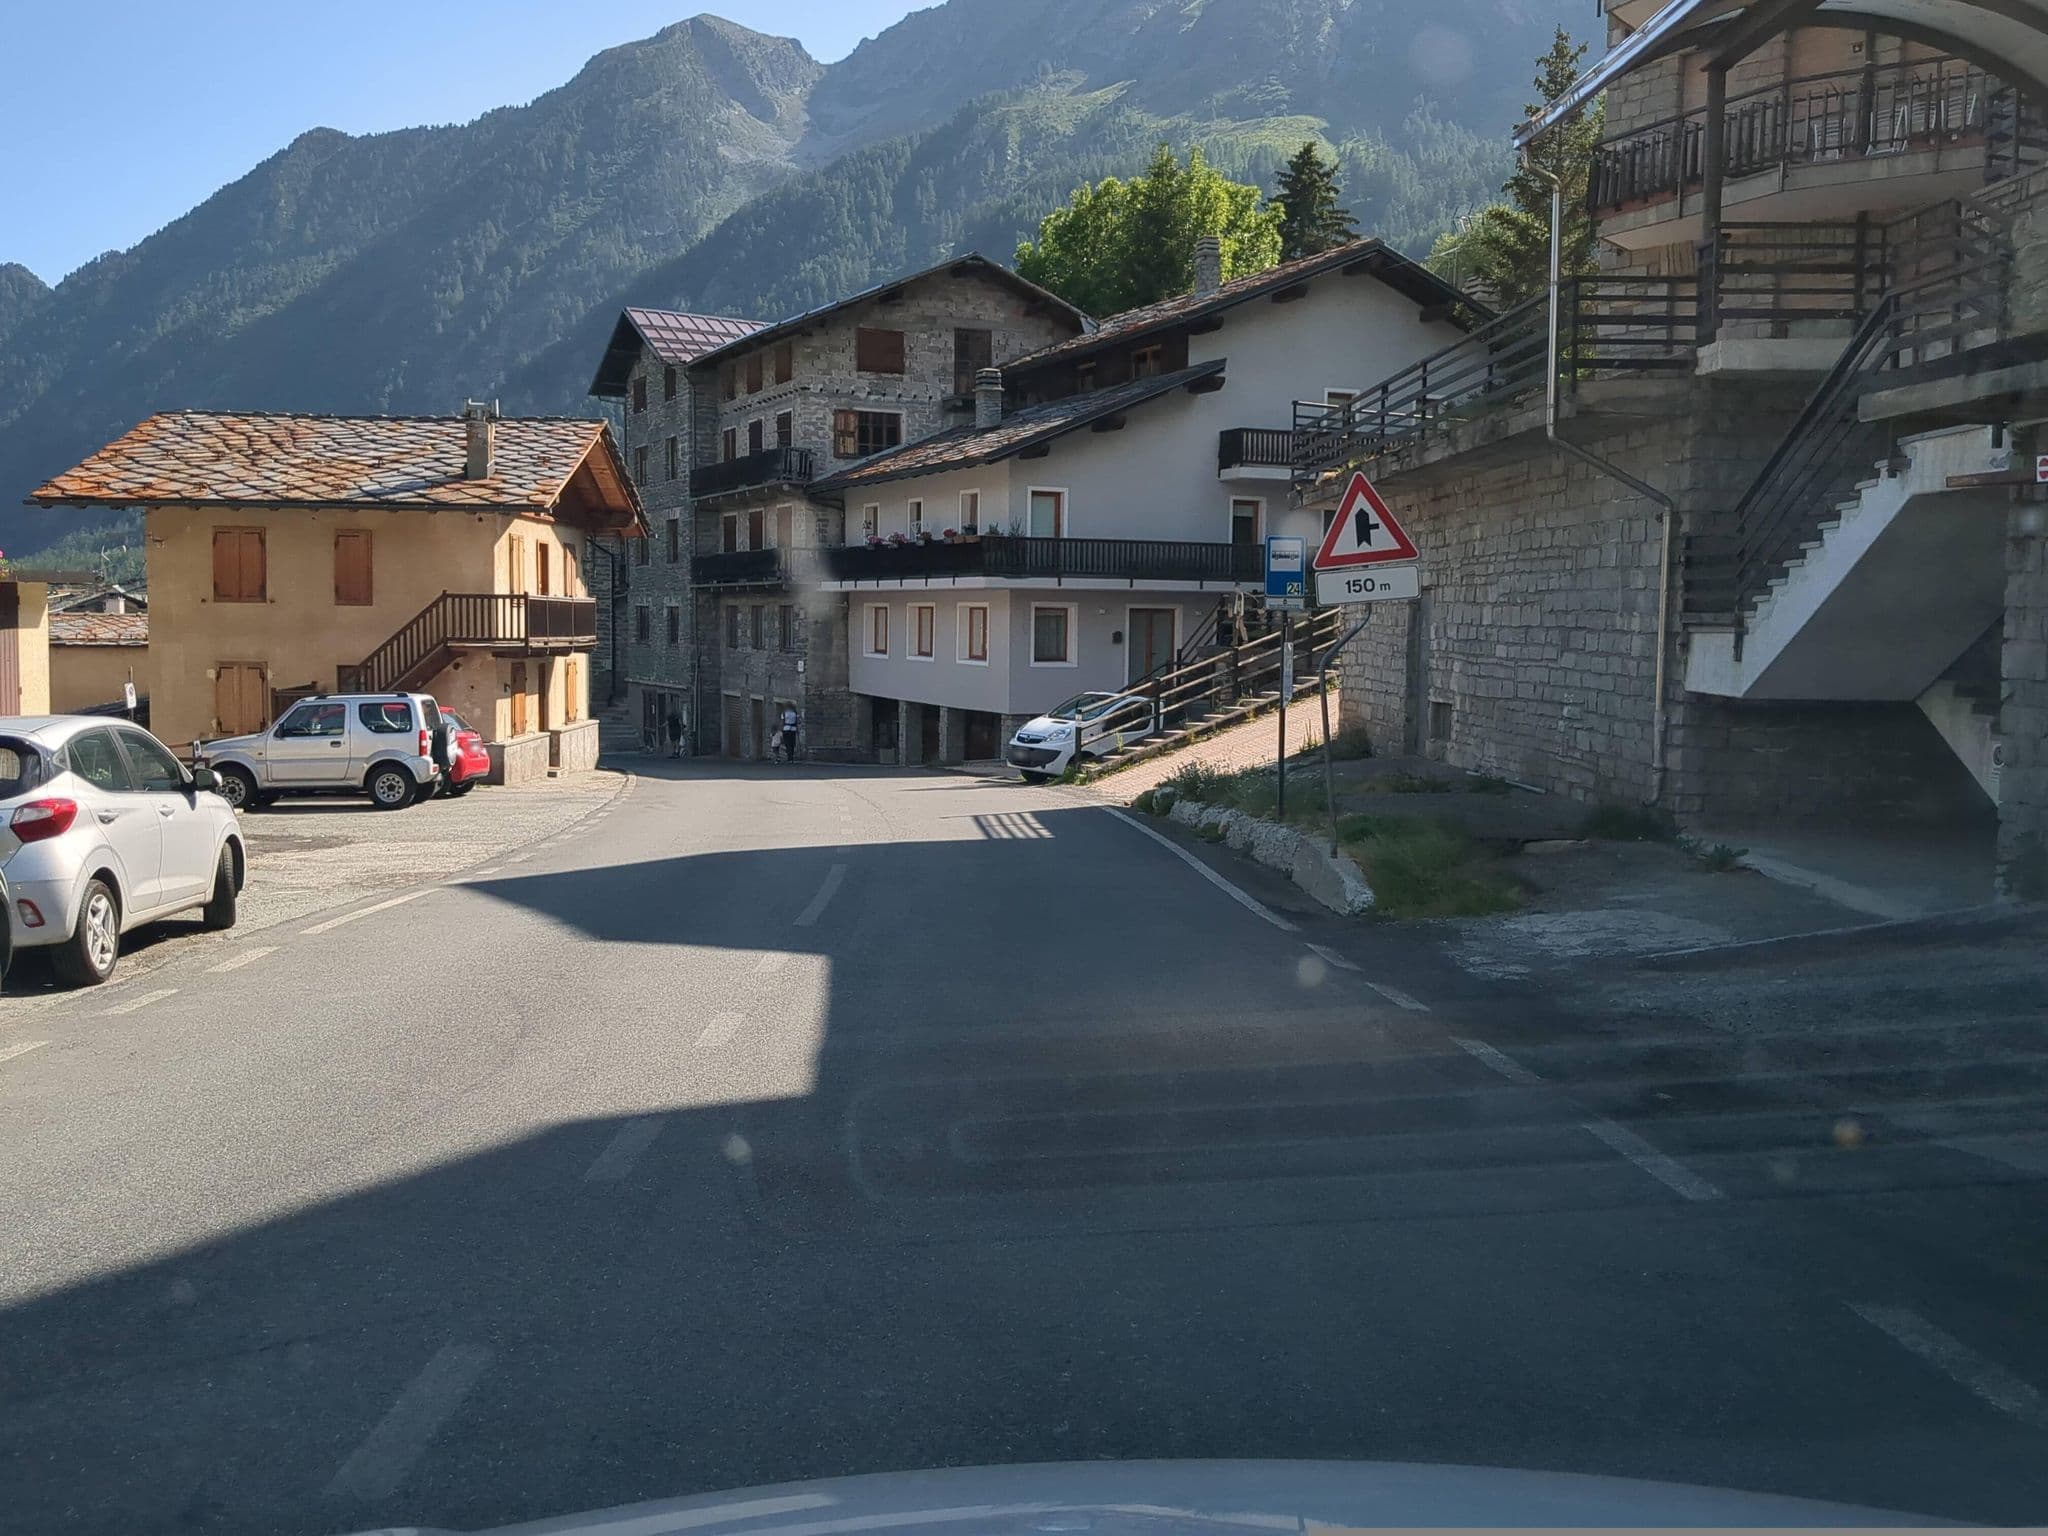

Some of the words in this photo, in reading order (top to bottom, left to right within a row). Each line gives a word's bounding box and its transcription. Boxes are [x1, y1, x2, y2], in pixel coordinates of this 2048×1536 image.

[1287, 582, 1300, 595] 24
[1345, 578, 1375, 593] 150
[1379, 582, 1391, 592] m
